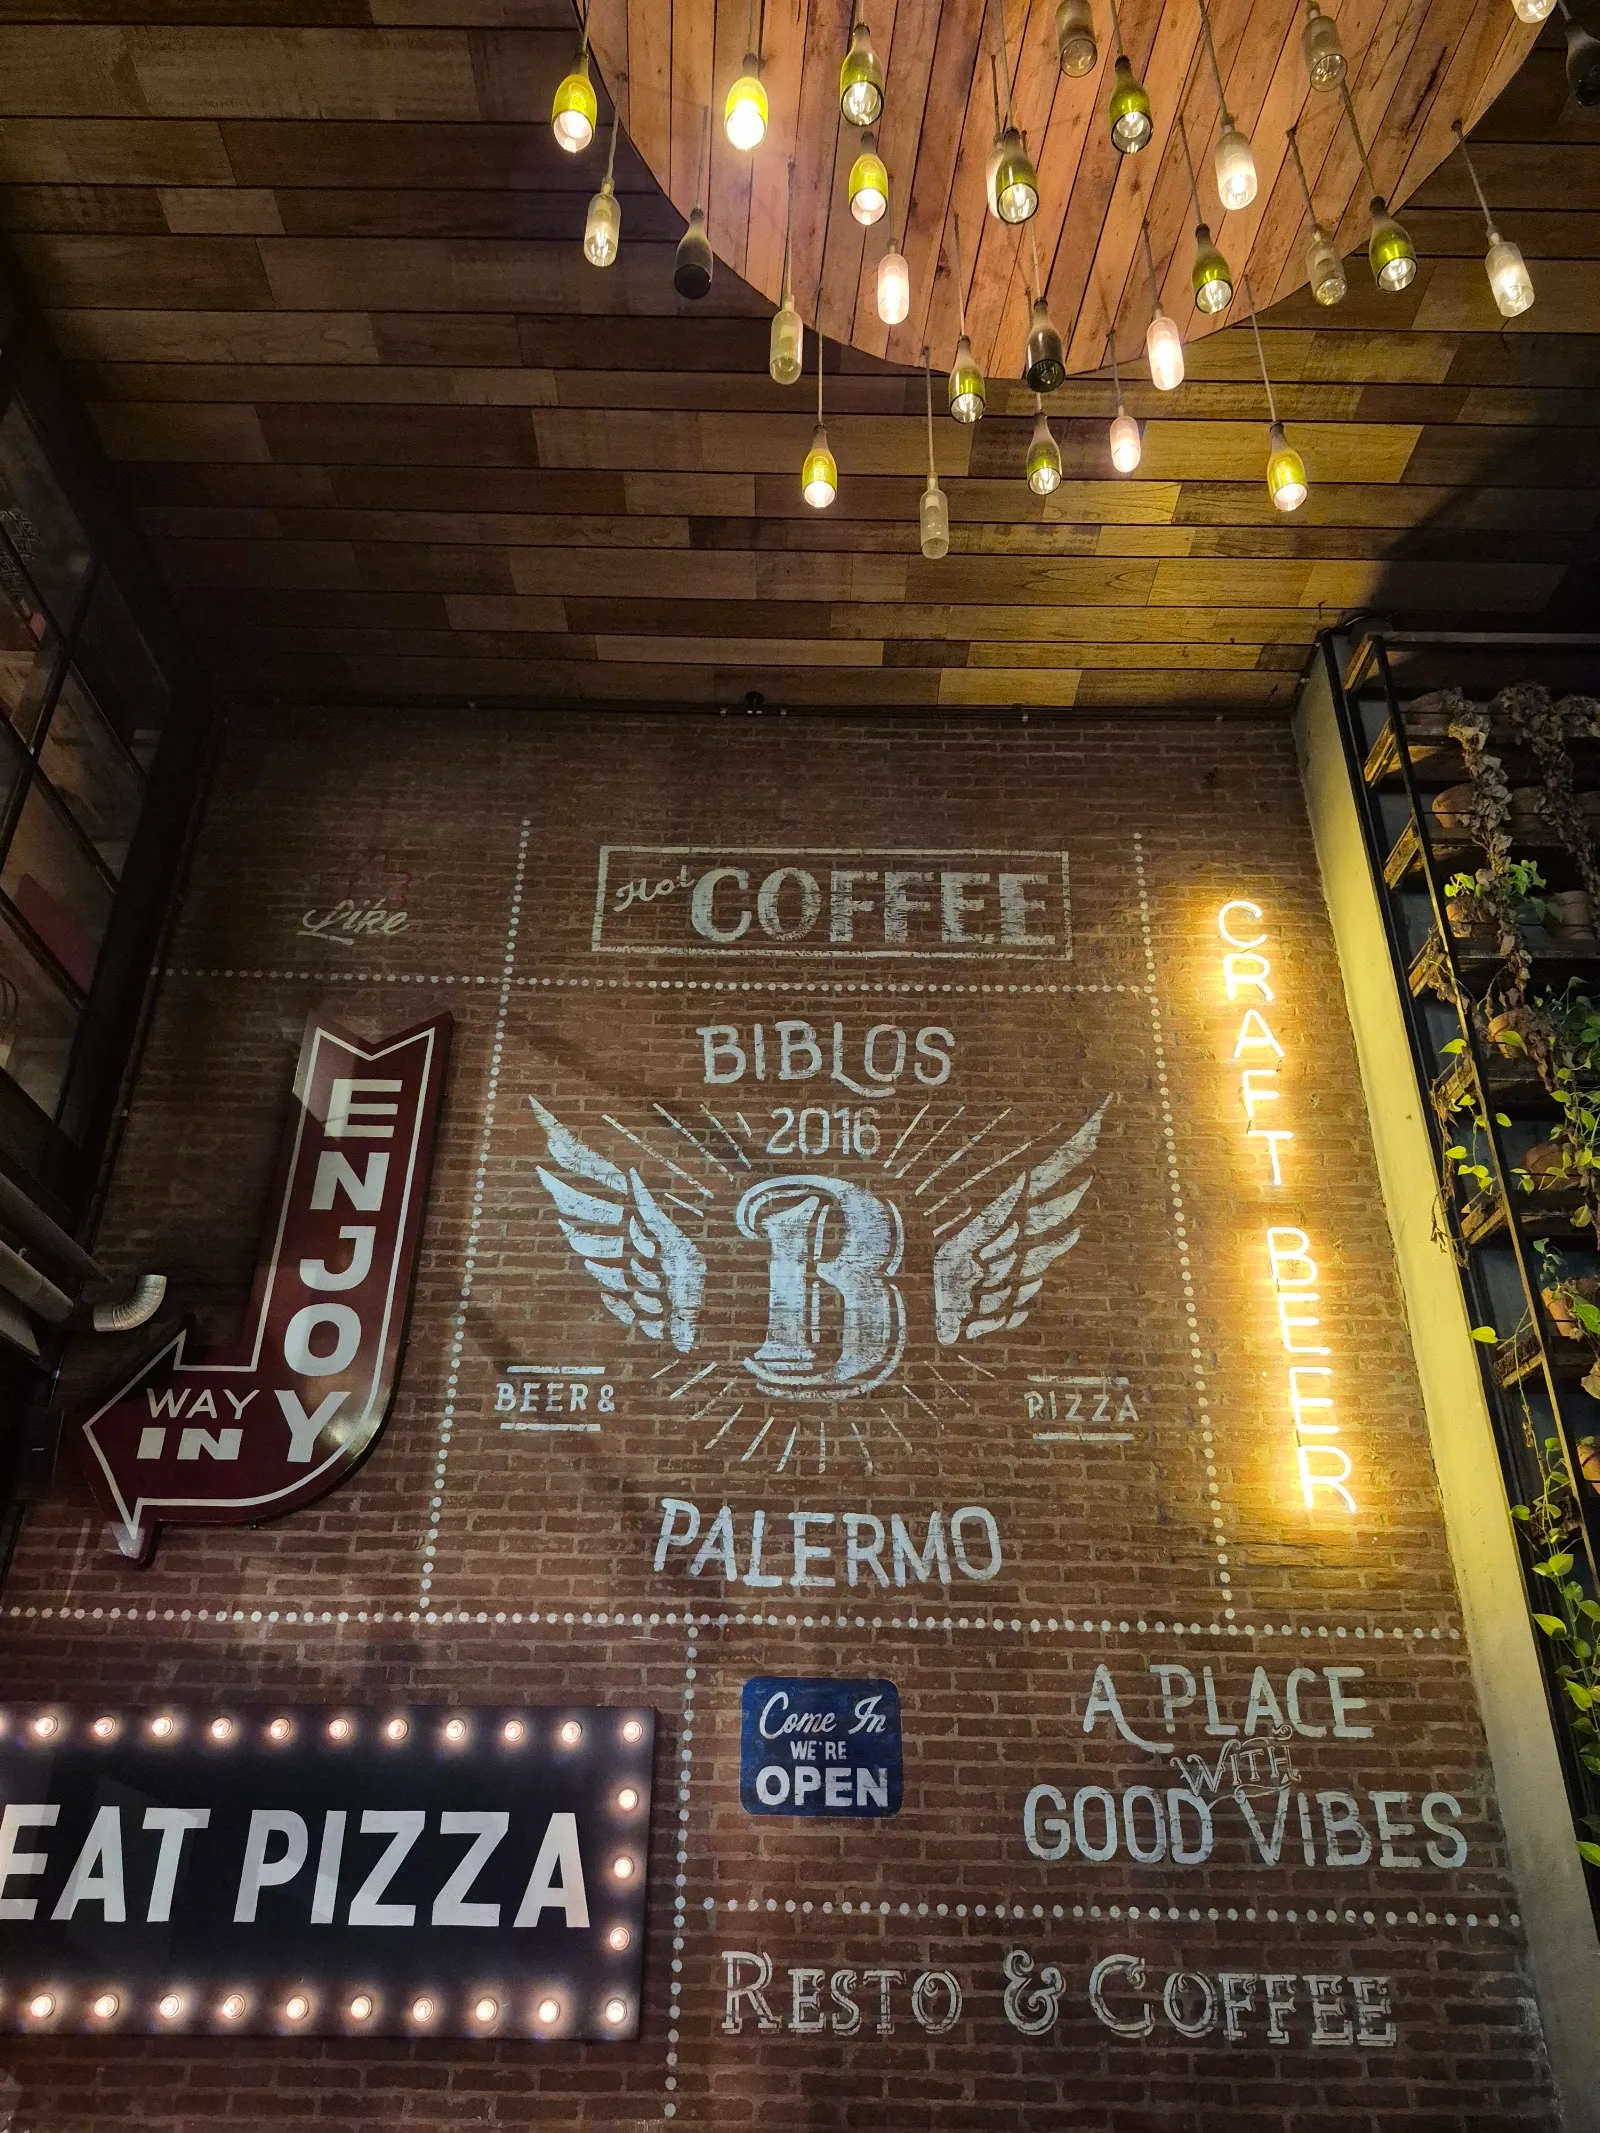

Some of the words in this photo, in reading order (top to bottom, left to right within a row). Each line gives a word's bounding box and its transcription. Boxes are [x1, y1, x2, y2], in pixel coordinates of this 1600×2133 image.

[296, 898, 410, 945] Like
[613, 865, 694, 912] Hot
[691, 867, 1055, 945] COFFEE
[696, 1020, 955, 1099] BIBLOS
[766, 1107, 880, 1155] 2016
[1217, 900, 1294, 1187] CRAFT
[1266, 1226, 1358, 1514] BEER
[274, 1078, 403, 1463] ENJOY
[146, 1387, 261, 1420] WAY
[1023, 1390, 1140, 1421] PIZZA
[136, 1427, 244, 1460] IN
[653, 1498, 1003, 1588] PALERMO
[759, 1691, 837, 1739] Come
[847, 1694, 887, 1735] In
[1082, 1664, 1174, 1754] A
[1149, 1664, 1375, 1738] PLACE
[755, 1765, 889, 1807] OPEN
[789, 1740, 847, 1761] WE'RE
[1169, 1725, 1302, 1798] WITH
[1023, 1784, 1214, 1865] GOOD
[1233, 1785, 1468, 1869] VIBES
[0, 1803, 211, 1923] EAT
[233, 1808, 591, 1929] PIZZA
[721, 1950, 963, 2035] RESTO
[1003, 1949, 1067, 2036] &
[1089, 1953, 1397, 2047] COFFEE
